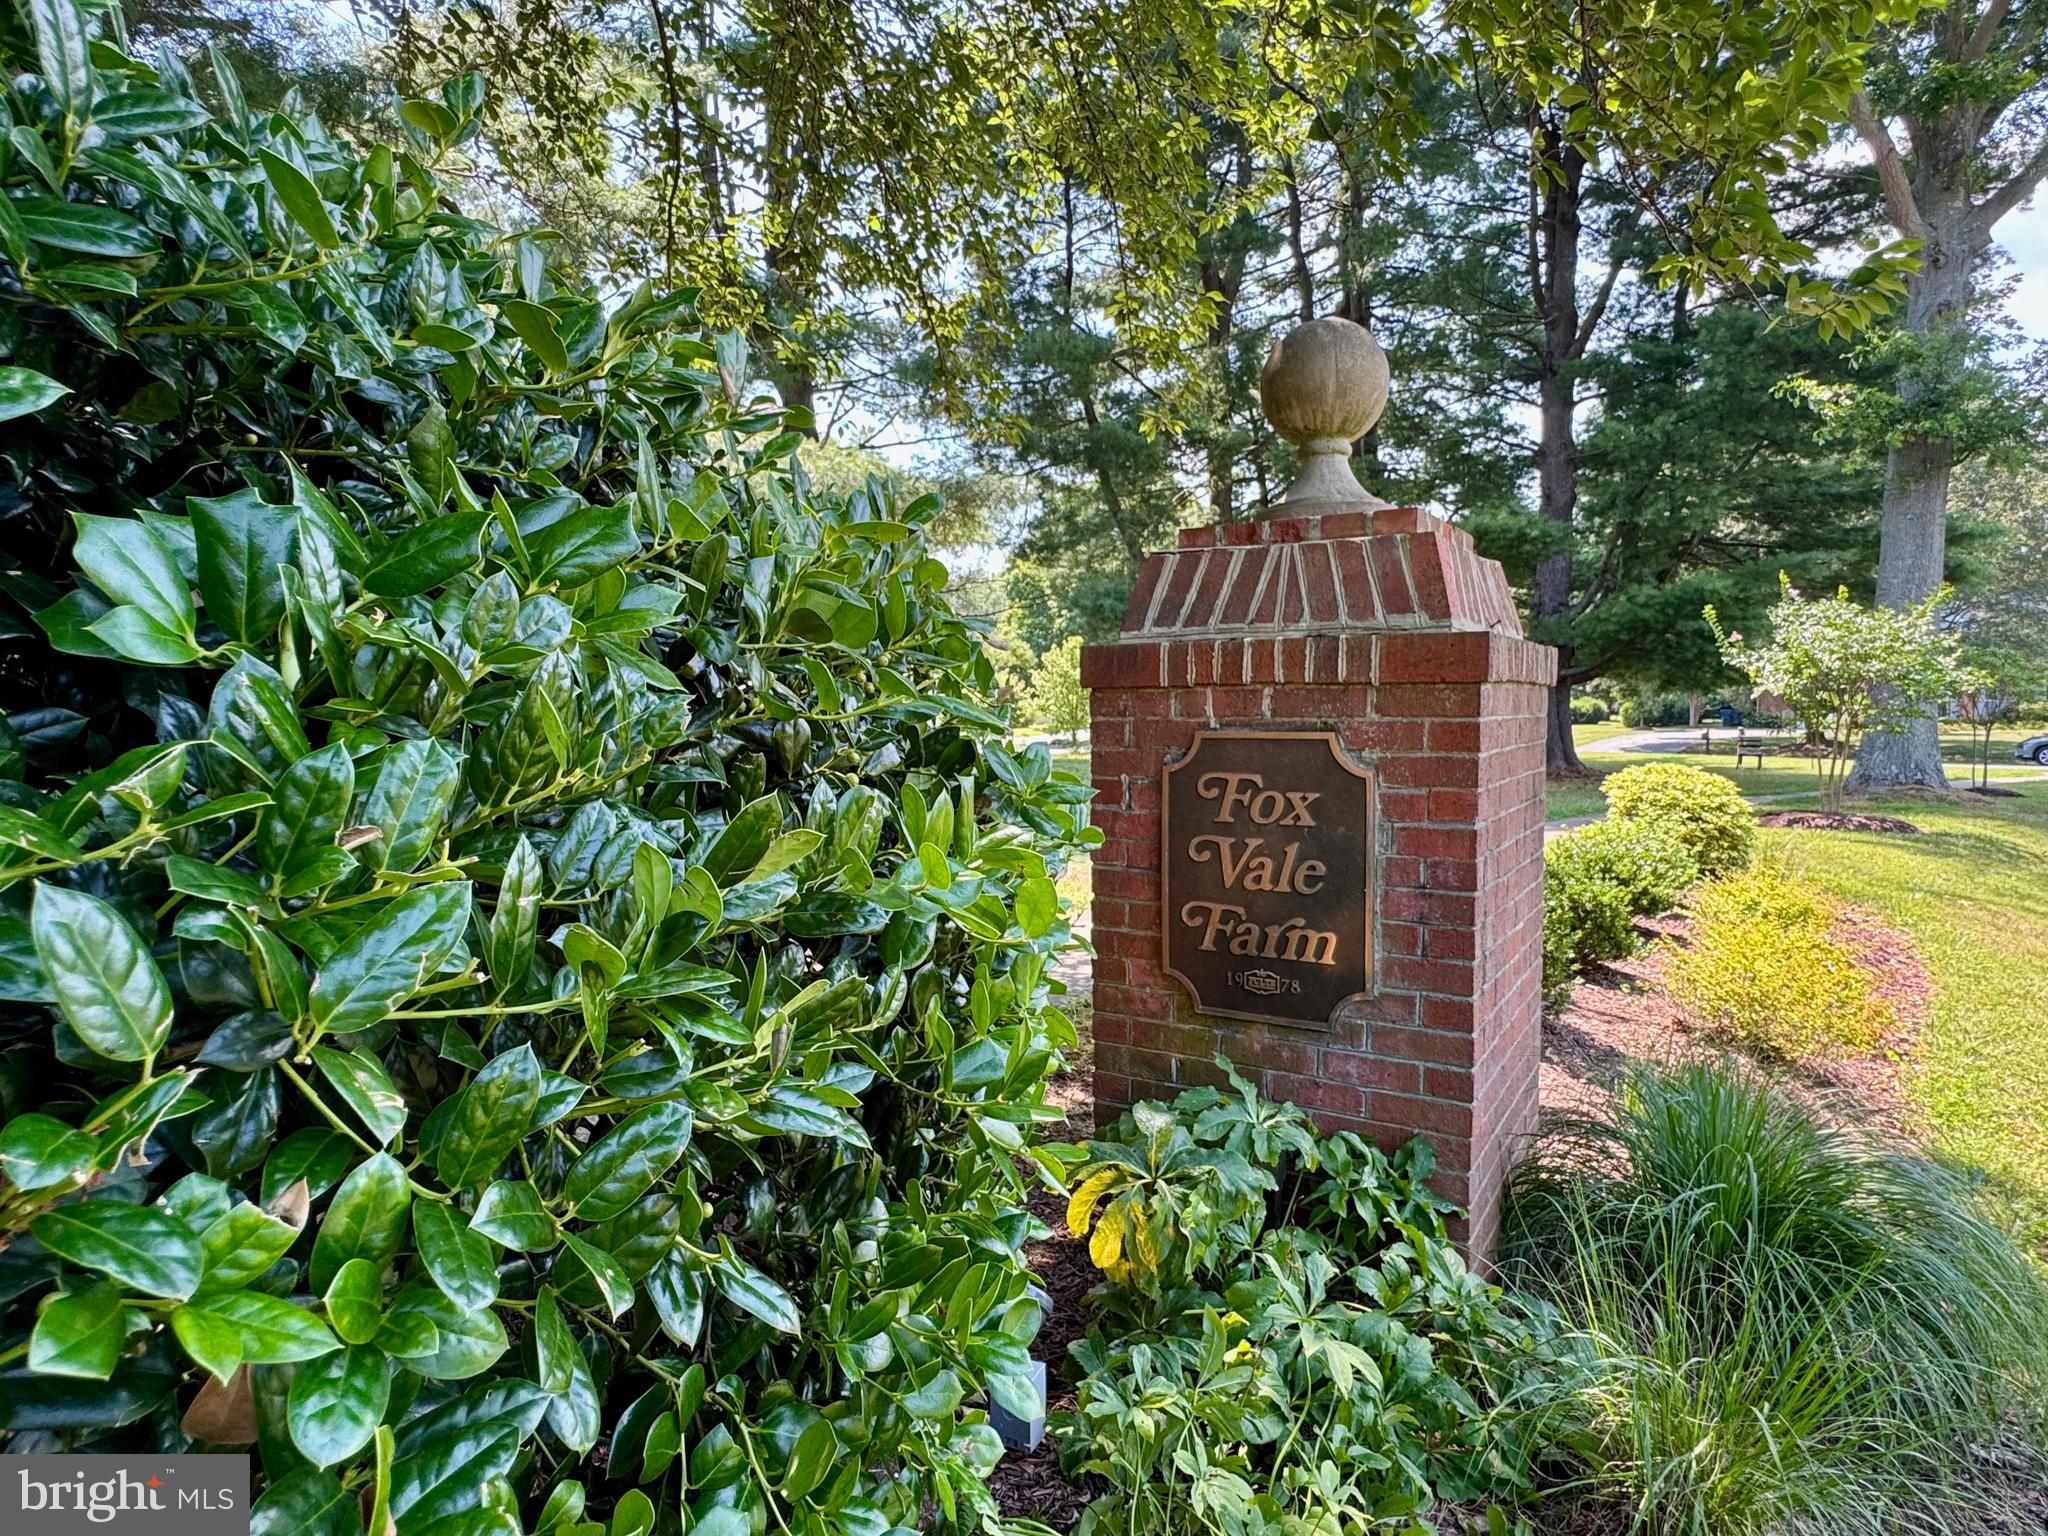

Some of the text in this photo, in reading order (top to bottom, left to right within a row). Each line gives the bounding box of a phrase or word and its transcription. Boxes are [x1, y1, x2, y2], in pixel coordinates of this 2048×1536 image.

[1197, 772, 1320, 827] Fox
[1188, 834, 1327, 894] Vale
[1181, 901, 1337, 965] Farm
